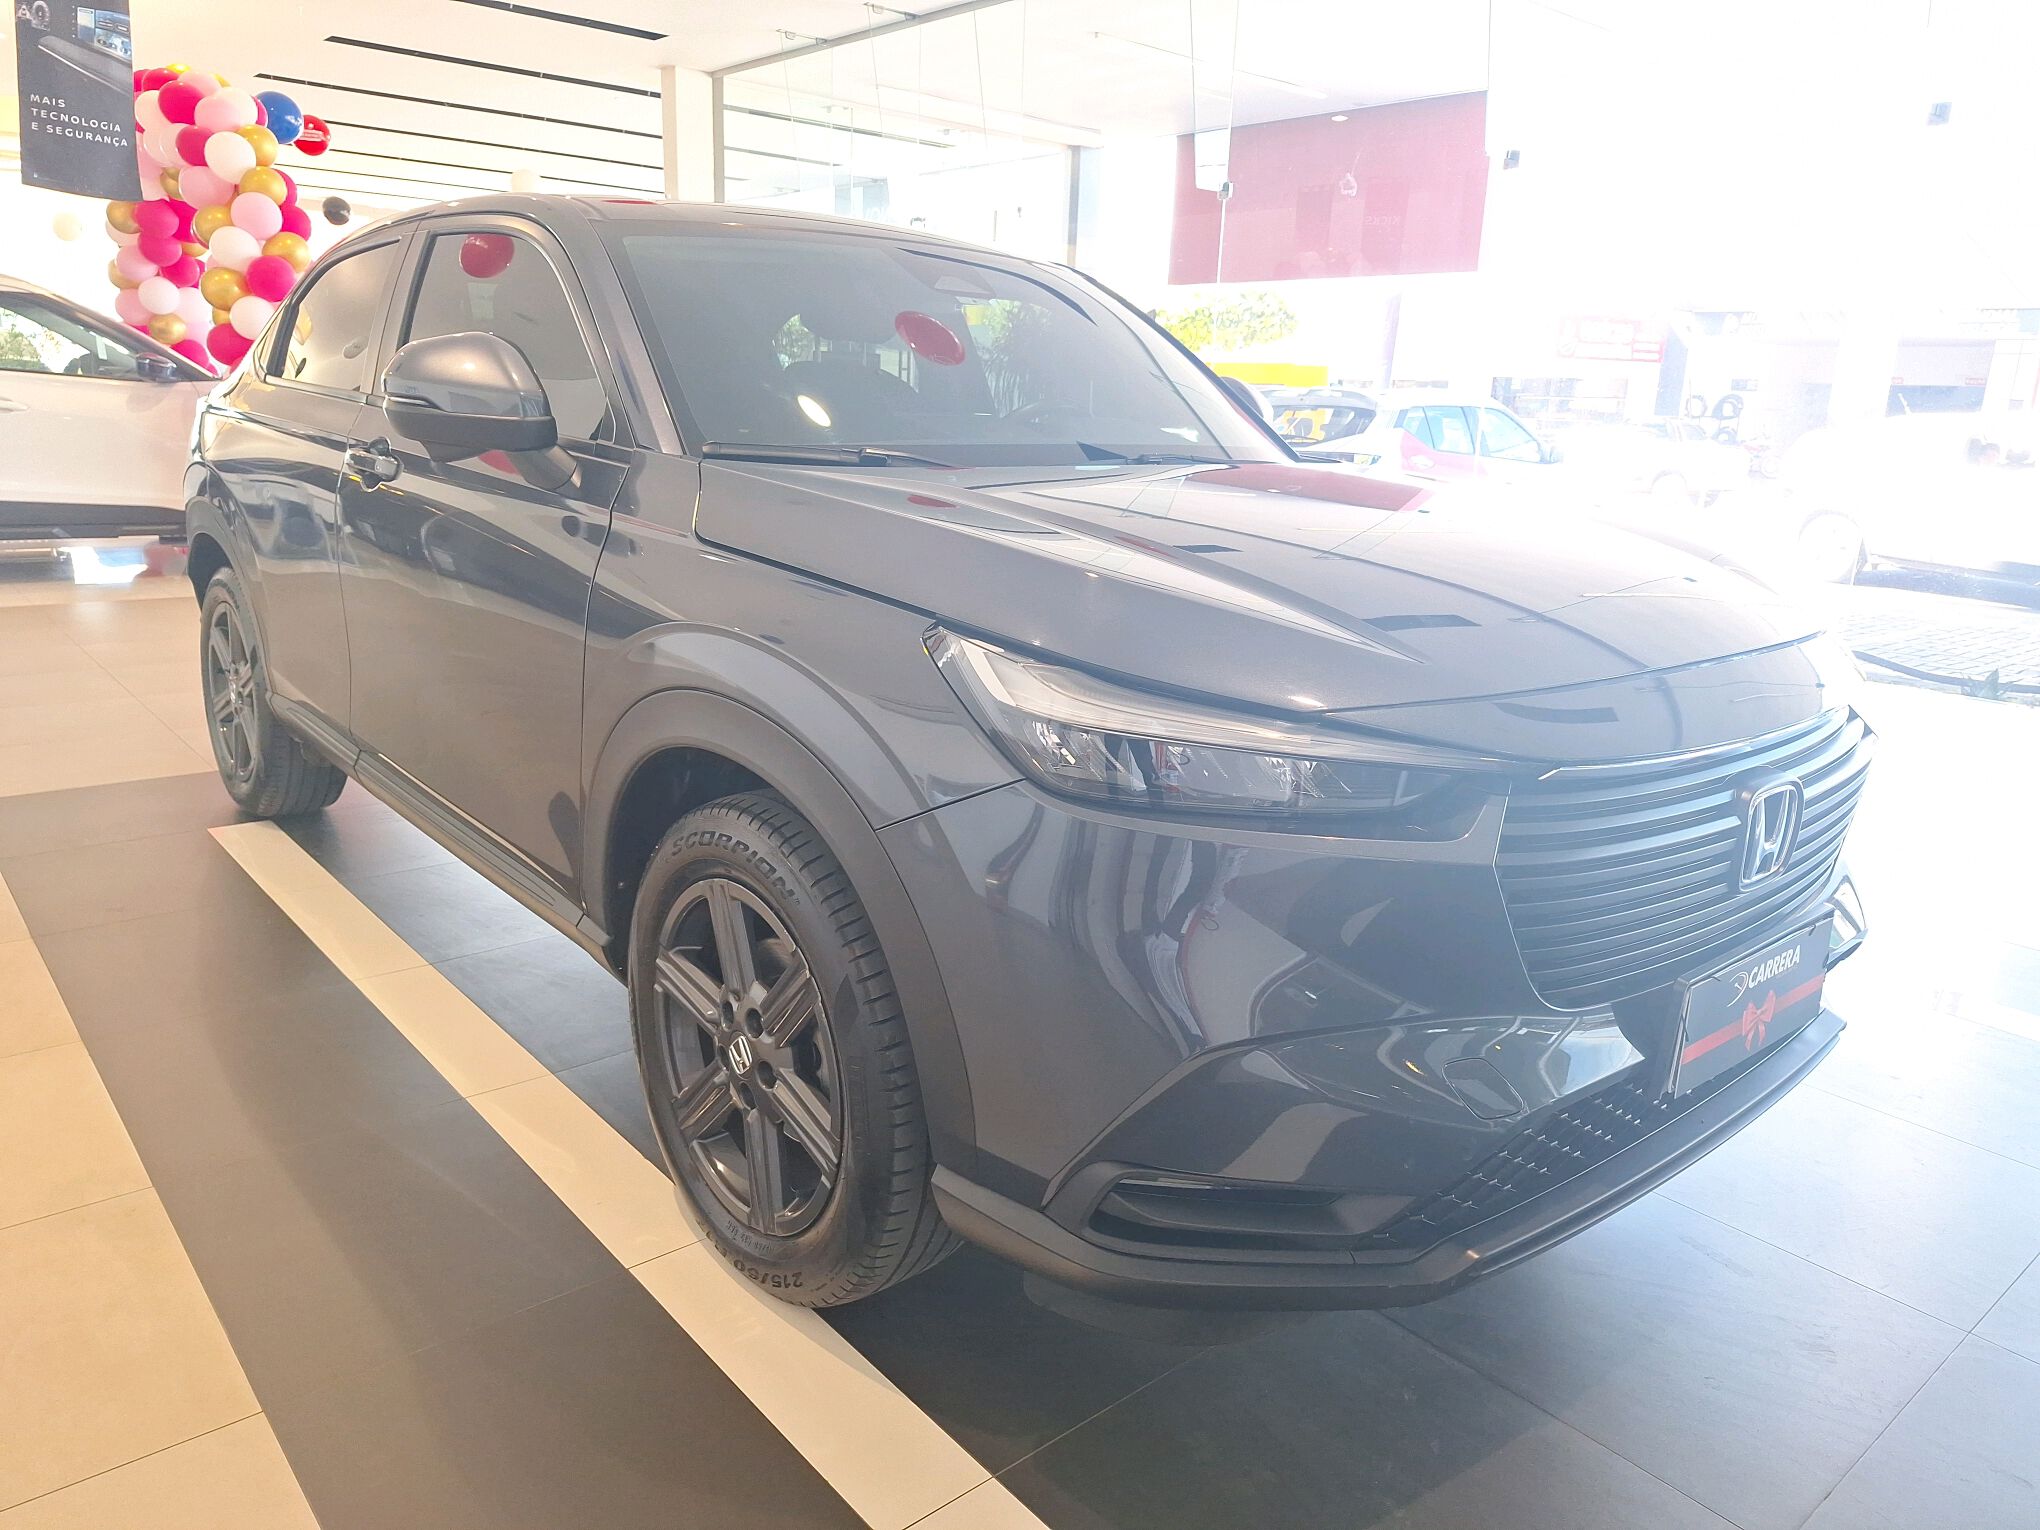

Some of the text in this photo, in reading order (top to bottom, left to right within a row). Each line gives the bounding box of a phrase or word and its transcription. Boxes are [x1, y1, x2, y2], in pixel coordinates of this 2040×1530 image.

[30, 94, 66, 108] MAIS
[31, 108, 121, 132] TECNOLOGIA
[31, 122, 128, 147] E SEGURANÇA
[671, 830, 797, 898] SCORPION
[1748, 944, 1801, 989] CARRERA
[733, 1259, 803, 1288] 215/60
